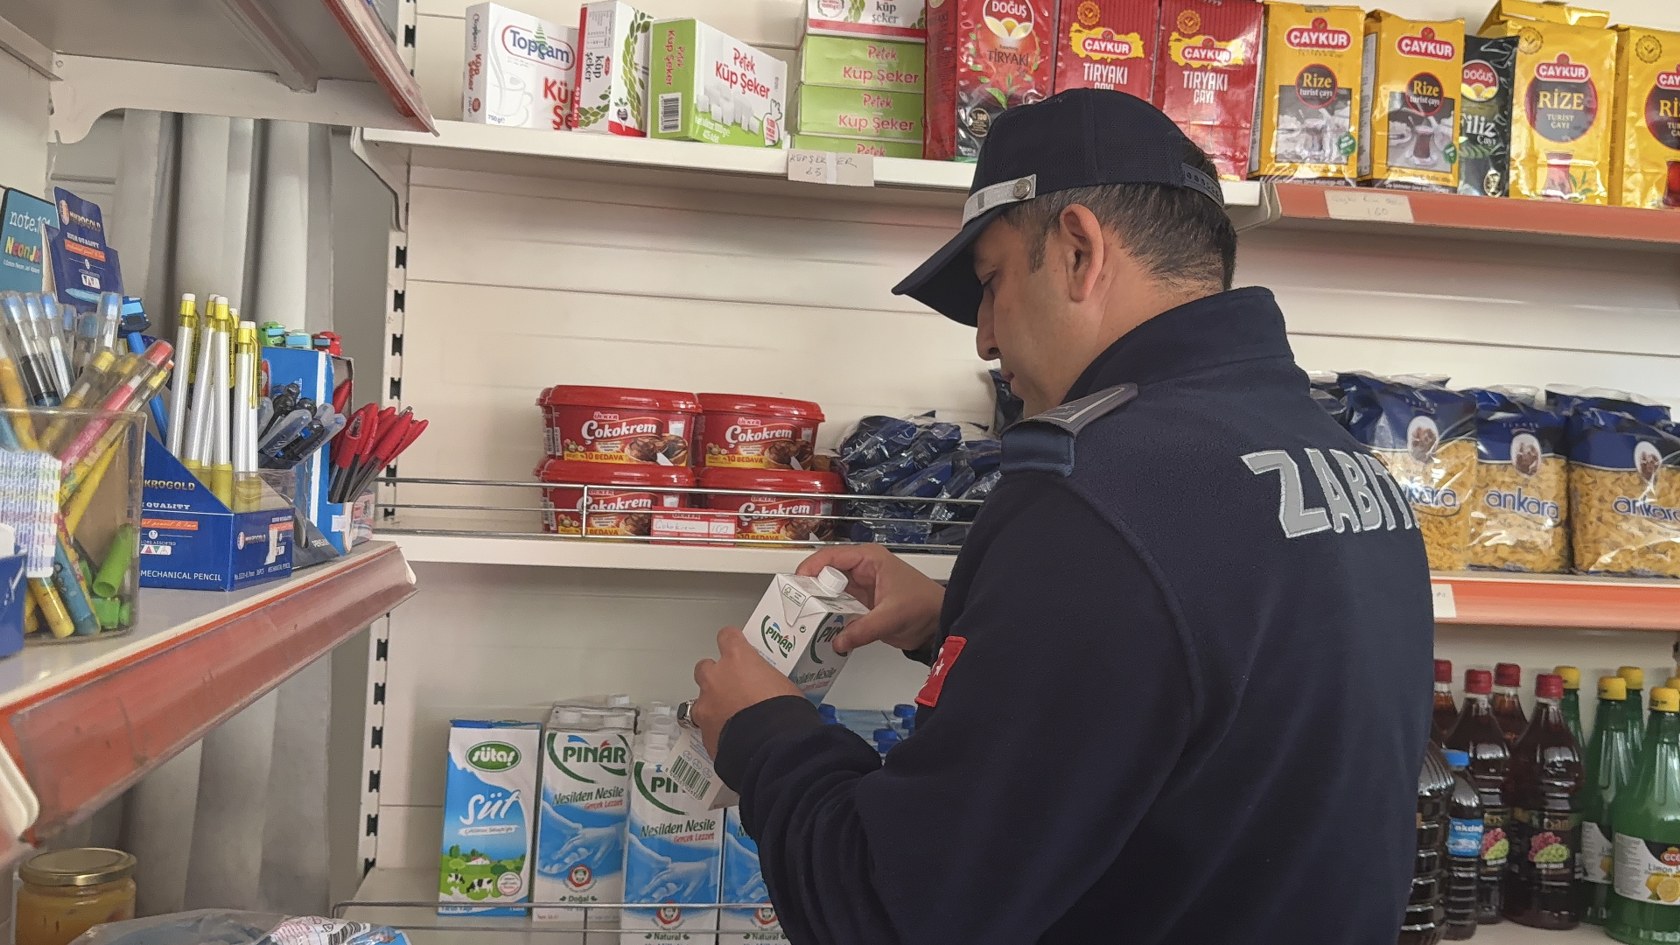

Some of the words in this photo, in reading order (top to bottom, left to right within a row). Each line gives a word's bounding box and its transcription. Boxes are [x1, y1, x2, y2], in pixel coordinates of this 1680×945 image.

[876, 1, 897, 14] küp
[991, 1, 1027, 18] DOĞUŞ
[872, 12, 899, 23] şeker
[510, 30, 570, 64] Topçam
[1084, 39, 1130, 55] ÇAYKUR
[1290, 32, 1348, 47] ÇAYKUR
[1401, 39, 1453, 57] ÇAYKUR
[733, 47, 756, 73] Petek
[867, 45, 898, 61] Petek
[1184, 48, 1231, 63] ÇAYKUR
[584, 51, 594, 82] şeker
[593, 55, 605, 79] küp
[1539, 64, 1586, 78] ÇAYKUR
[715, 61, 738, 89] Küp
[740, 73, 770, 99] Şeker
[843, 65, 875, 84] Küp
[876, 68, 919, 87] Şeker
[1302, 72, 1333, 89] Rize
[1463, 68, 1494, 83] DOĞUŞ
[1659, 74, 1680, 86] ÇAY
[1299, 88, 1319, 97] turist
[1413, 80, 1440, 97] Rize
[862, 93, 893, 109] Petek
[1192, 90, 1215, 106] ÇAYI
[1538, 88, 1585, 111] RİZE
[1659, 98, 1680, 118] Rİ
[838, 113, 869, 131] Küp
[871, 114, 915, 136] Şeker
[1551, 121, 1570, 130] ÇAYI
[857, 144, 886, 157] Petek
[581, 420, 657, 445] Çokokrem
[725, 425, 793, 449] Çokokrem
[594, 453, 624, 461] BEDAVA
[736, 455, 764, 464] BEDAVA
[144, 479, 196, 491] KROGOLD
[1240, 447, 1420, 539] ZABIT
[146, 502, 191, 510] QUALITY
[576, 496, 652, 520] Çokokrem
[1485, 486, 1559, 520] ankara
[738, 501, 811, 527] Çokokrem
[589, 528, 619, 536] BEDAVA
[140, 569, 192, 581] MECHANICAL
[193, 572, 223, 582] PENCIL
[766, 626, 793, 653] PINAR
[817, 626, 845, 644] PIN
[471, 746, 515, 767] sütaş
[562, 746, 627, 764] PINAR
[553, 791, 593, 805] Nesilden
[595, 786, 624, 799] Nesile
[460, 790, 522, 826] Süt
[641, 822, 683, 838] Nesilden
[684, 818, 716, 833] Nesile
[653, 932, 682, 941] Natural
[752, 932, 780, 941] Natural
